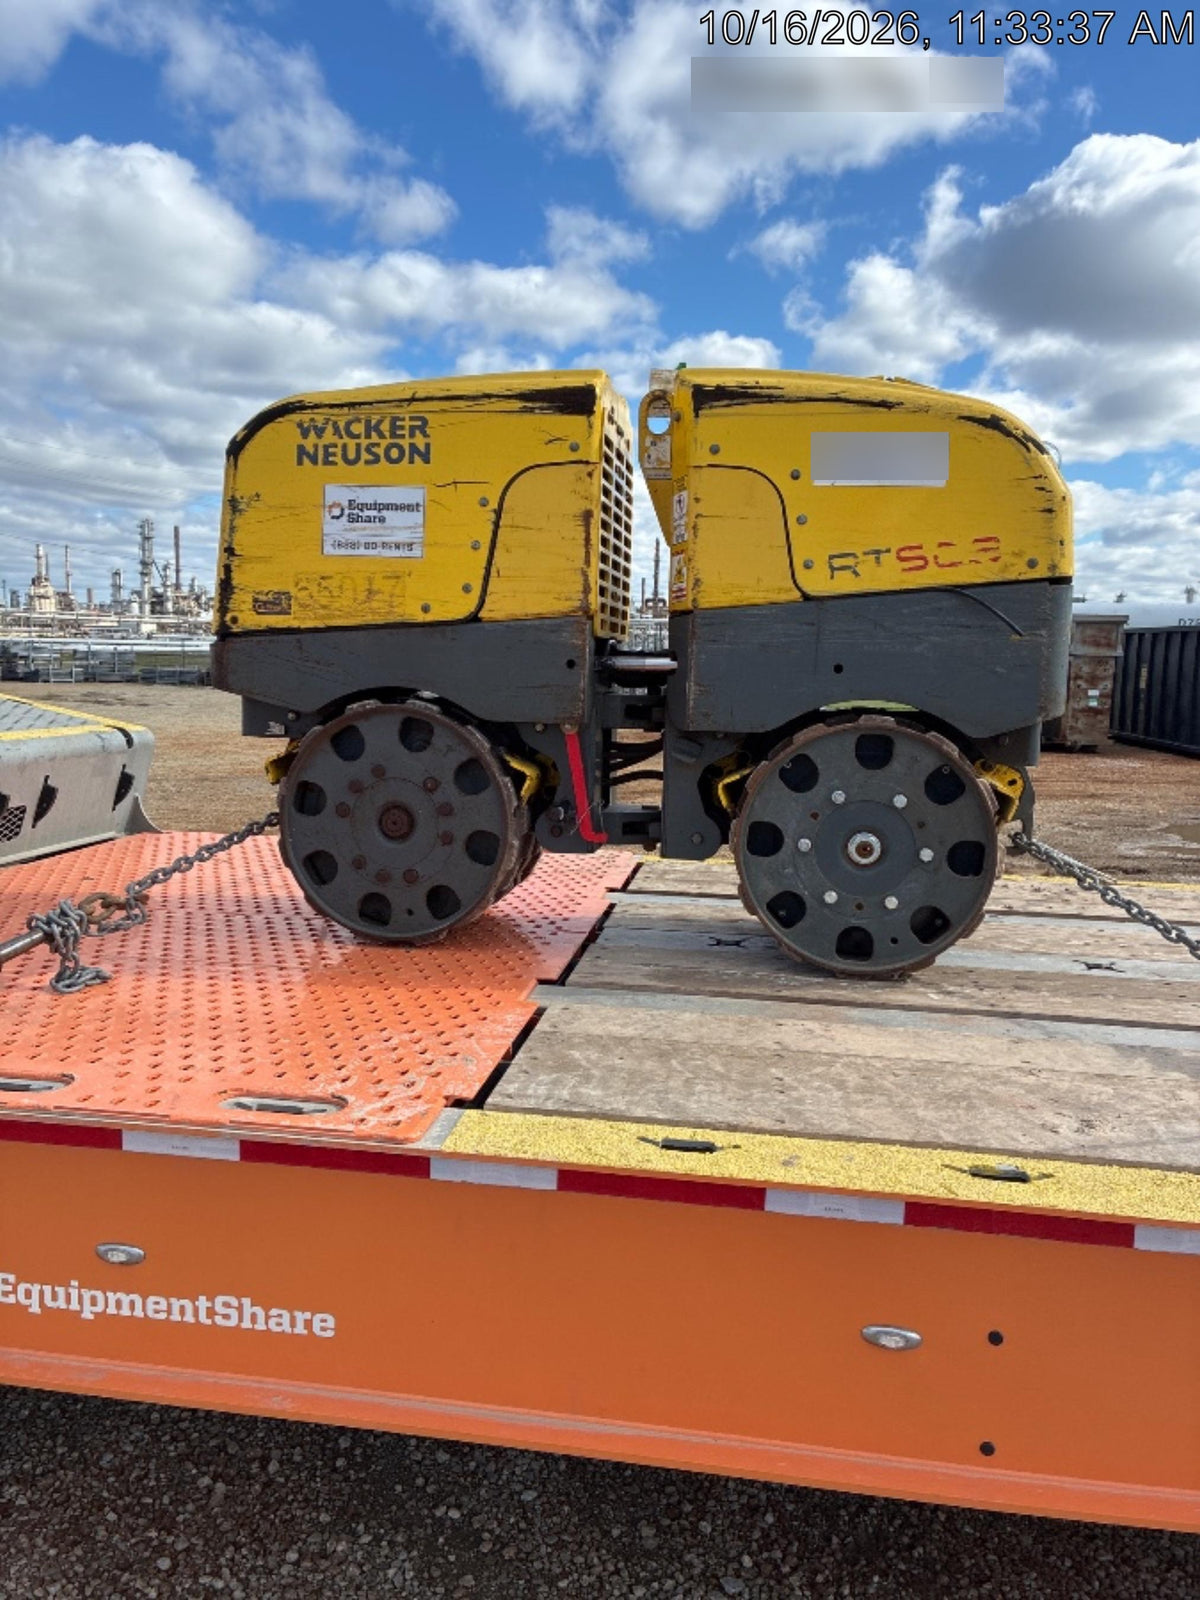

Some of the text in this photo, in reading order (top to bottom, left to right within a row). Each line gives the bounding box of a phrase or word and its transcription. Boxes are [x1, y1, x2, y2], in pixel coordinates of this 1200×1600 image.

[296, 415, 430, 439] WACKER
[296, 442, 431, 466] NEUSON
[347, 499, 421, 513] Equipment
[347, 512, 386, 524] Share
[0, 1272, 336, 1338] EquipmentShare
